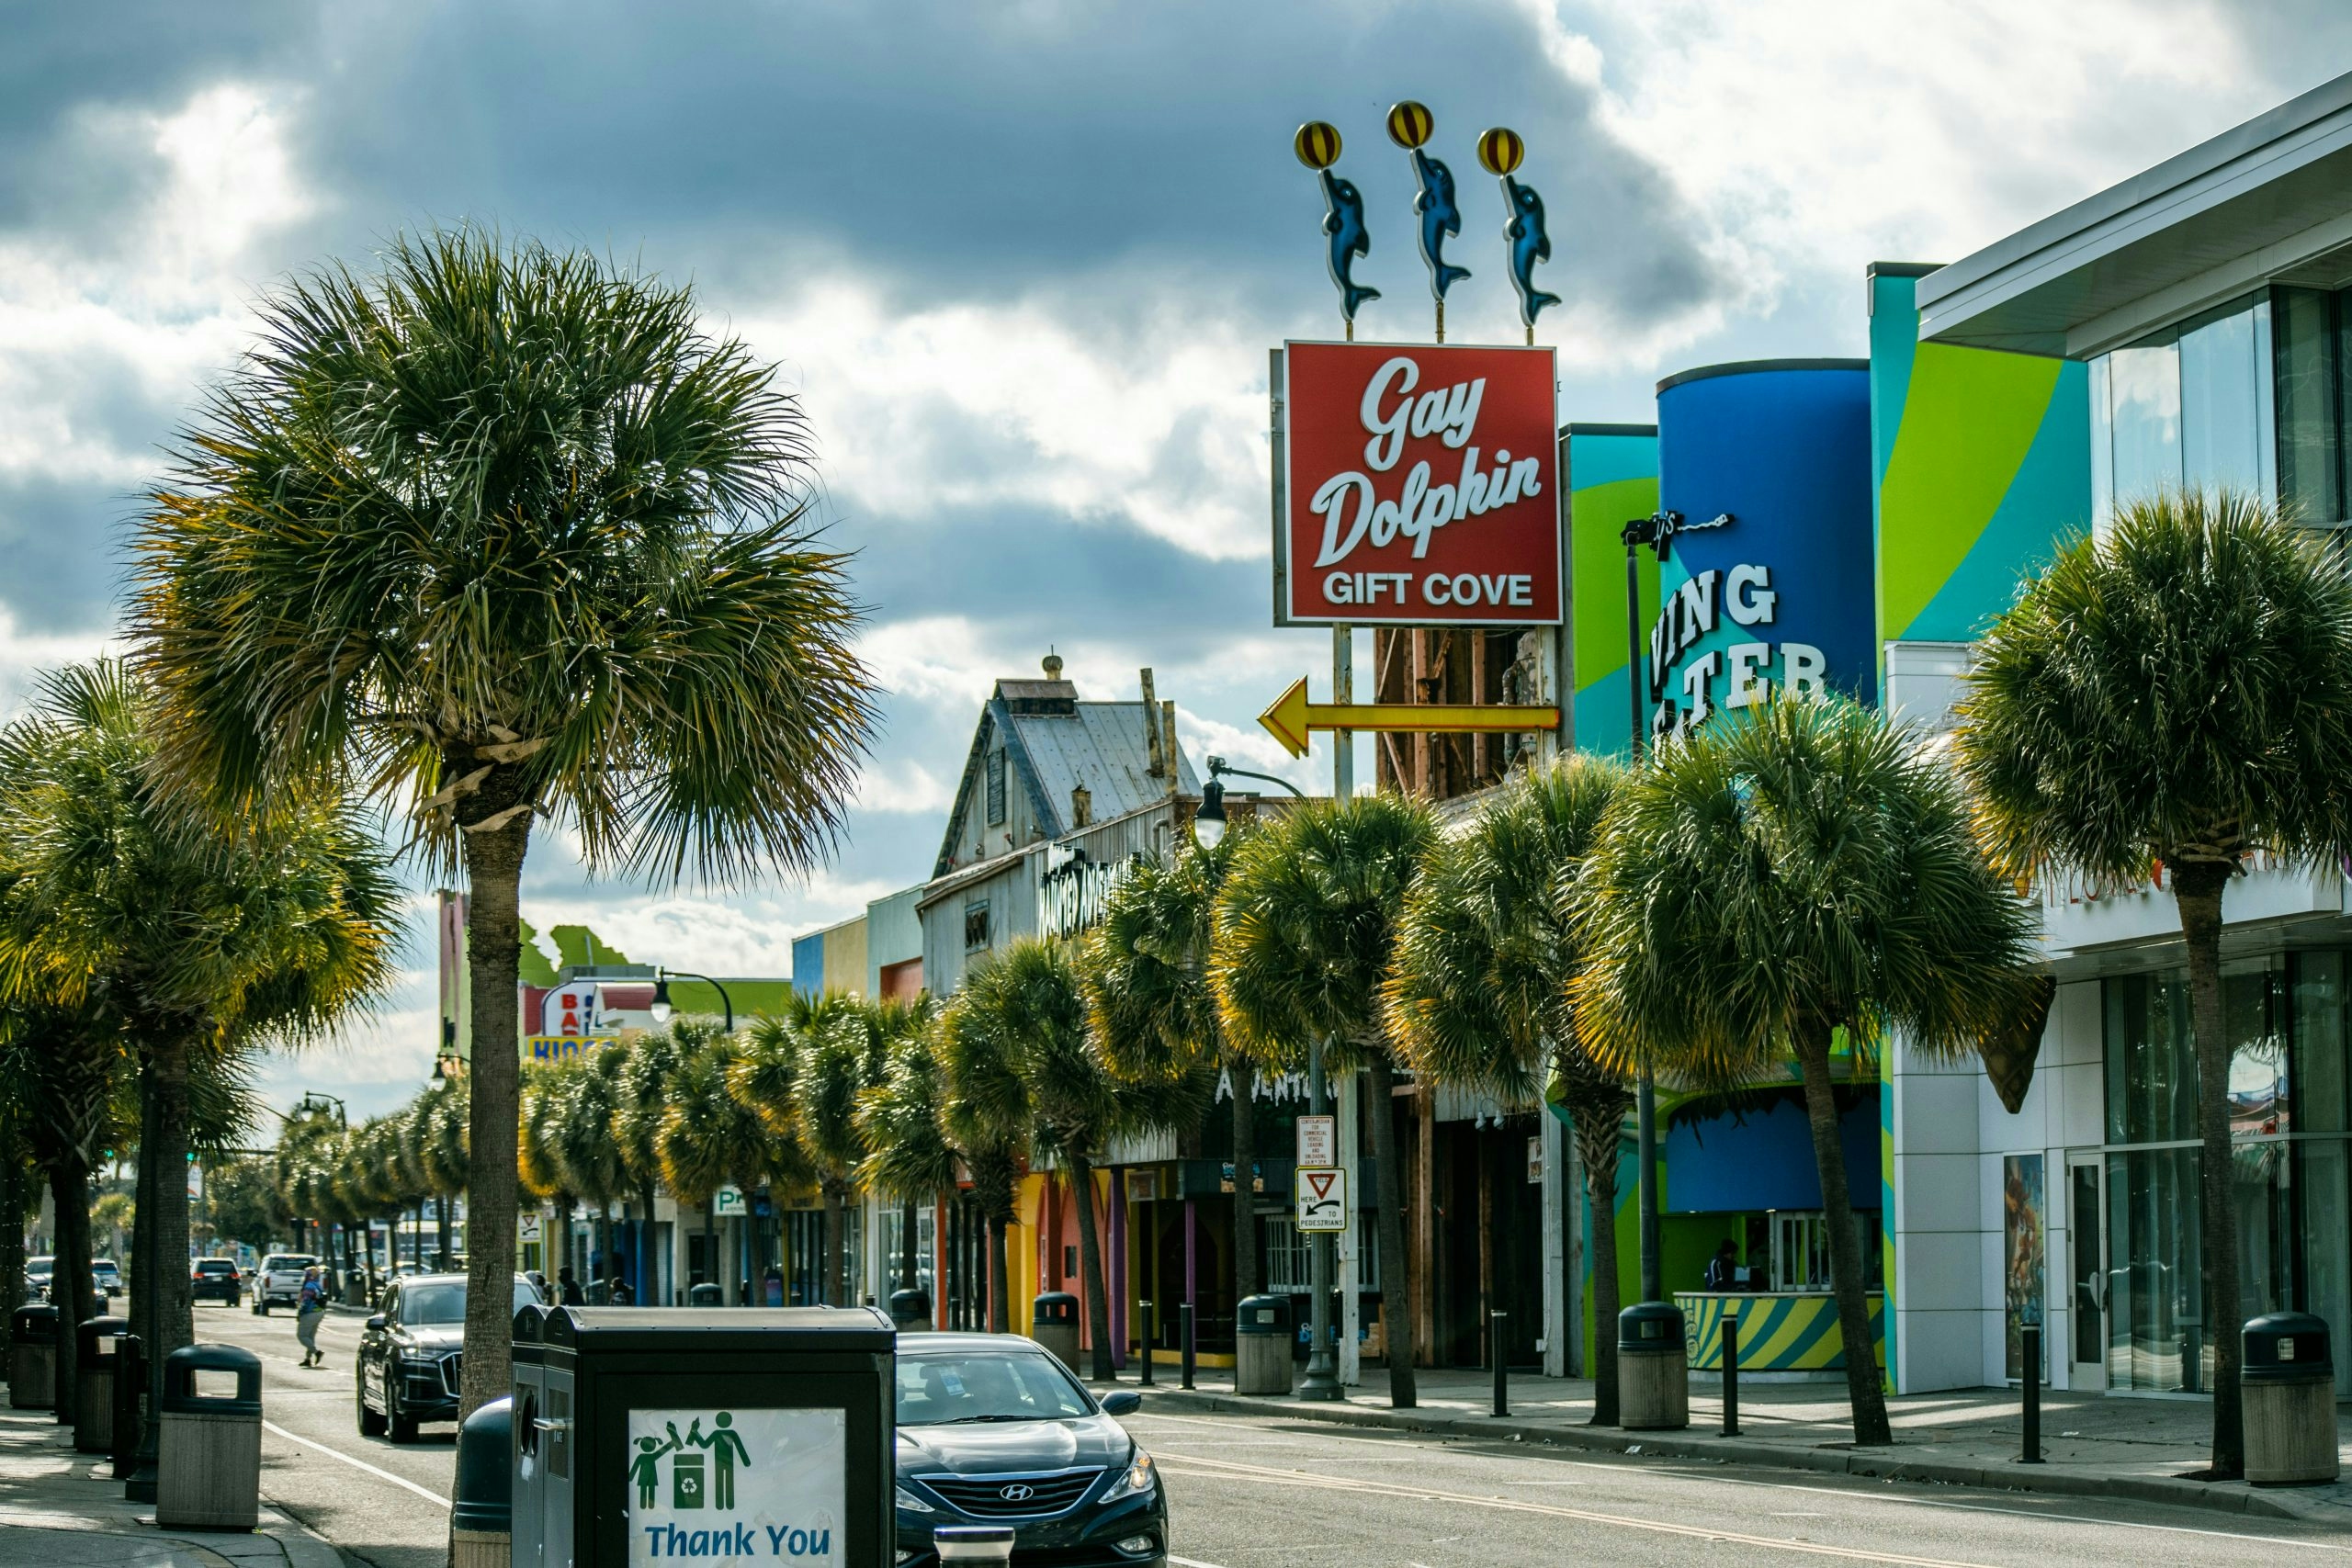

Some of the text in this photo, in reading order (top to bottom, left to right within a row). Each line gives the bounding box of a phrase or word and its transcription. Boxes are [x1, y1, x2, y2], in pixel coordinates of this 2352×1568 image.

[1360, 356, 1487, 471] Gay
[1310, 446, 1542, 568] Dolphin
[1323, 572, 1533, 606] GIFT COVE
[645, 1522, 830, 1557] Thank You
